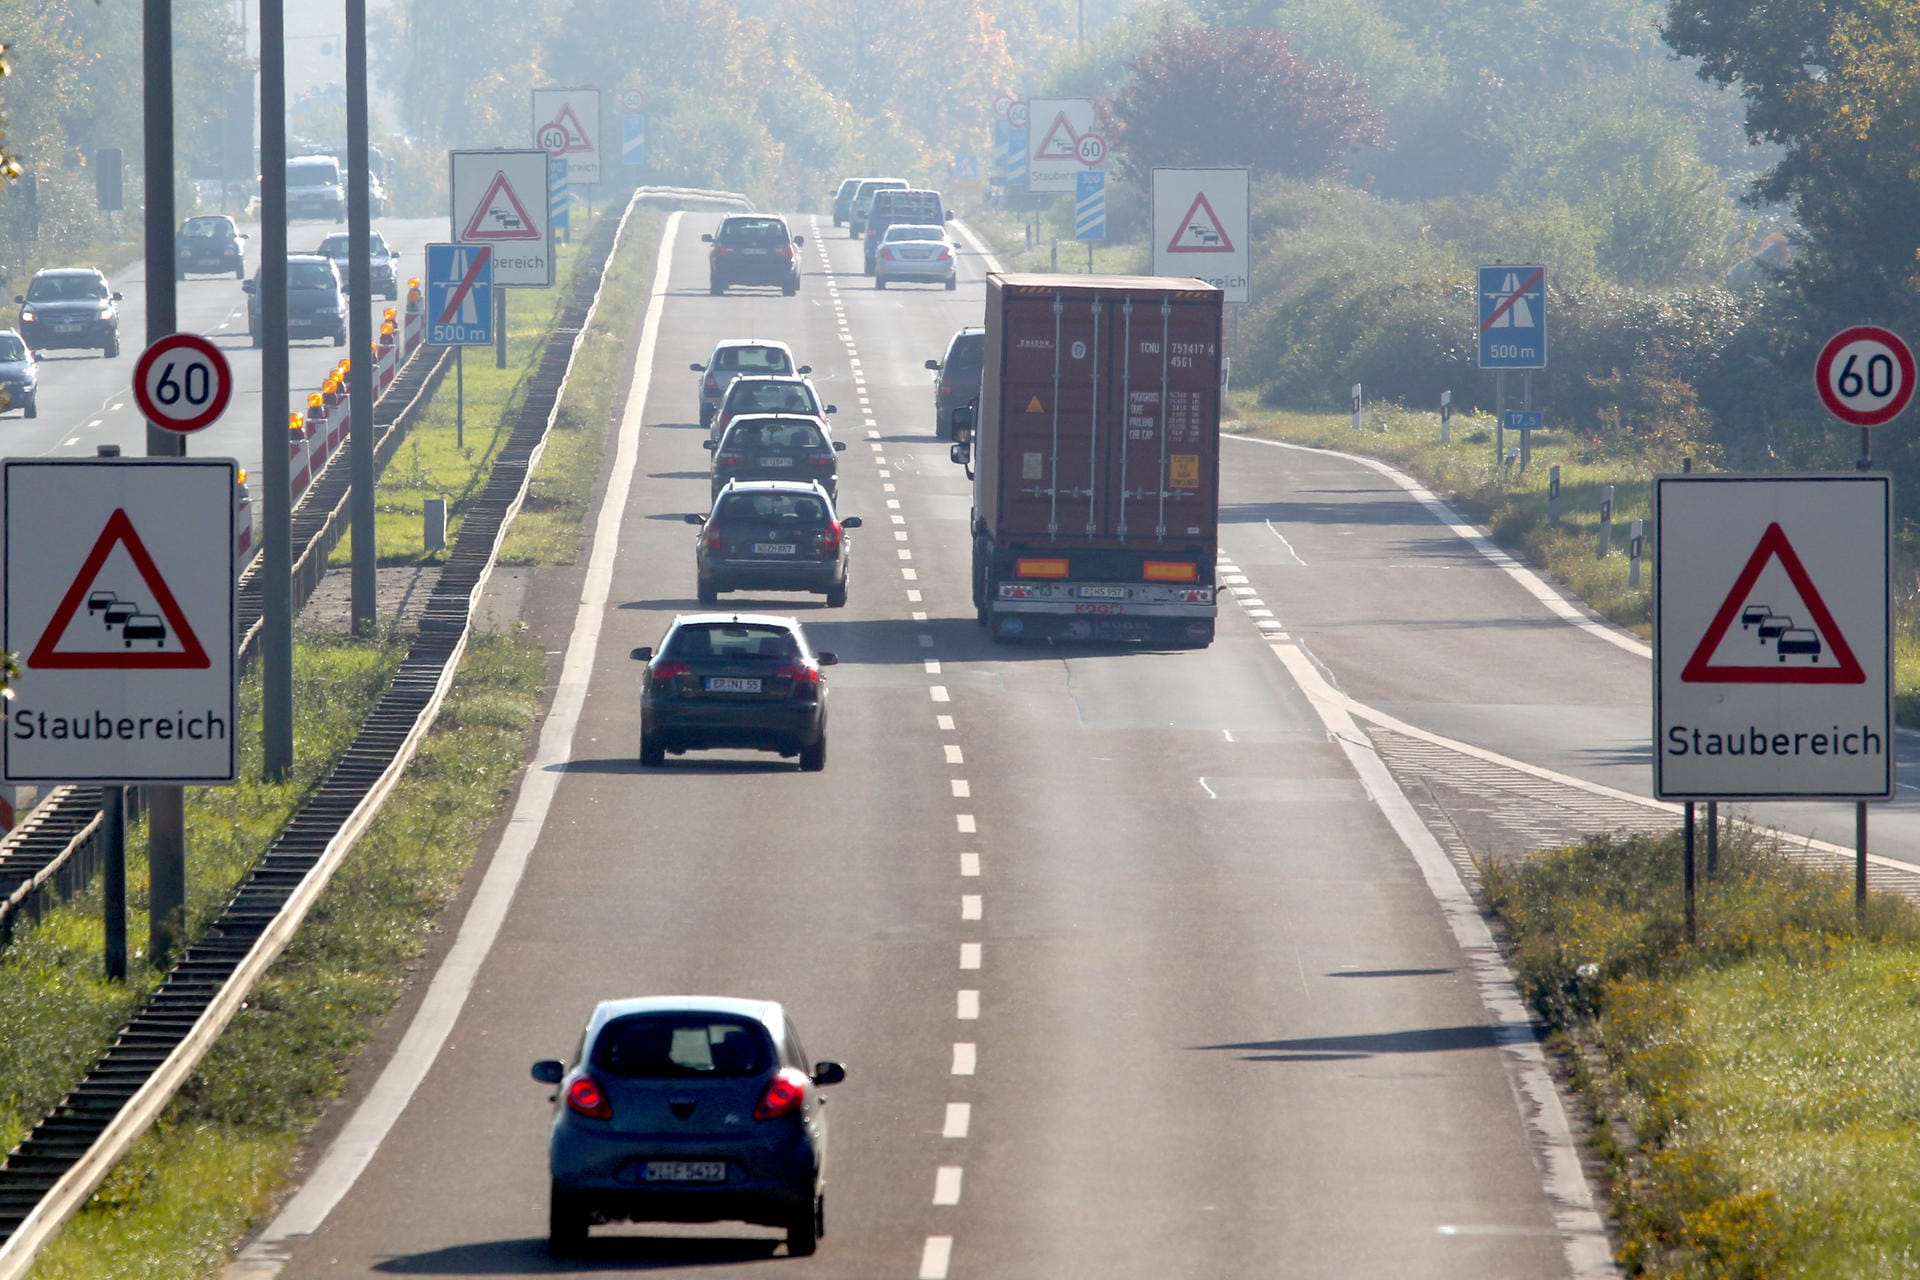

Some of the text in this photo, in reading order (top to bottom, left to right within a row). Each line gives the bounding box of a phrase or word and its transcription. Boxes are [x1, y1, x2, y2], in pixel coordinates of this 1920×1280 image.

[544, 132, 563, 148] 60
[1081, 142, 1100, 157] 60
[434, 325, 485, 341] 500 m
[1140, 342, 1160, 354] TCNU
[1490, 345, 1535, 358] 500 m
[156, 362, 209, 405] 60
[1838, 354, 1893, 398] 60
[14, 710, 225, 740] Staubereich
[1668, 725, 1881, 756] Staubereich
